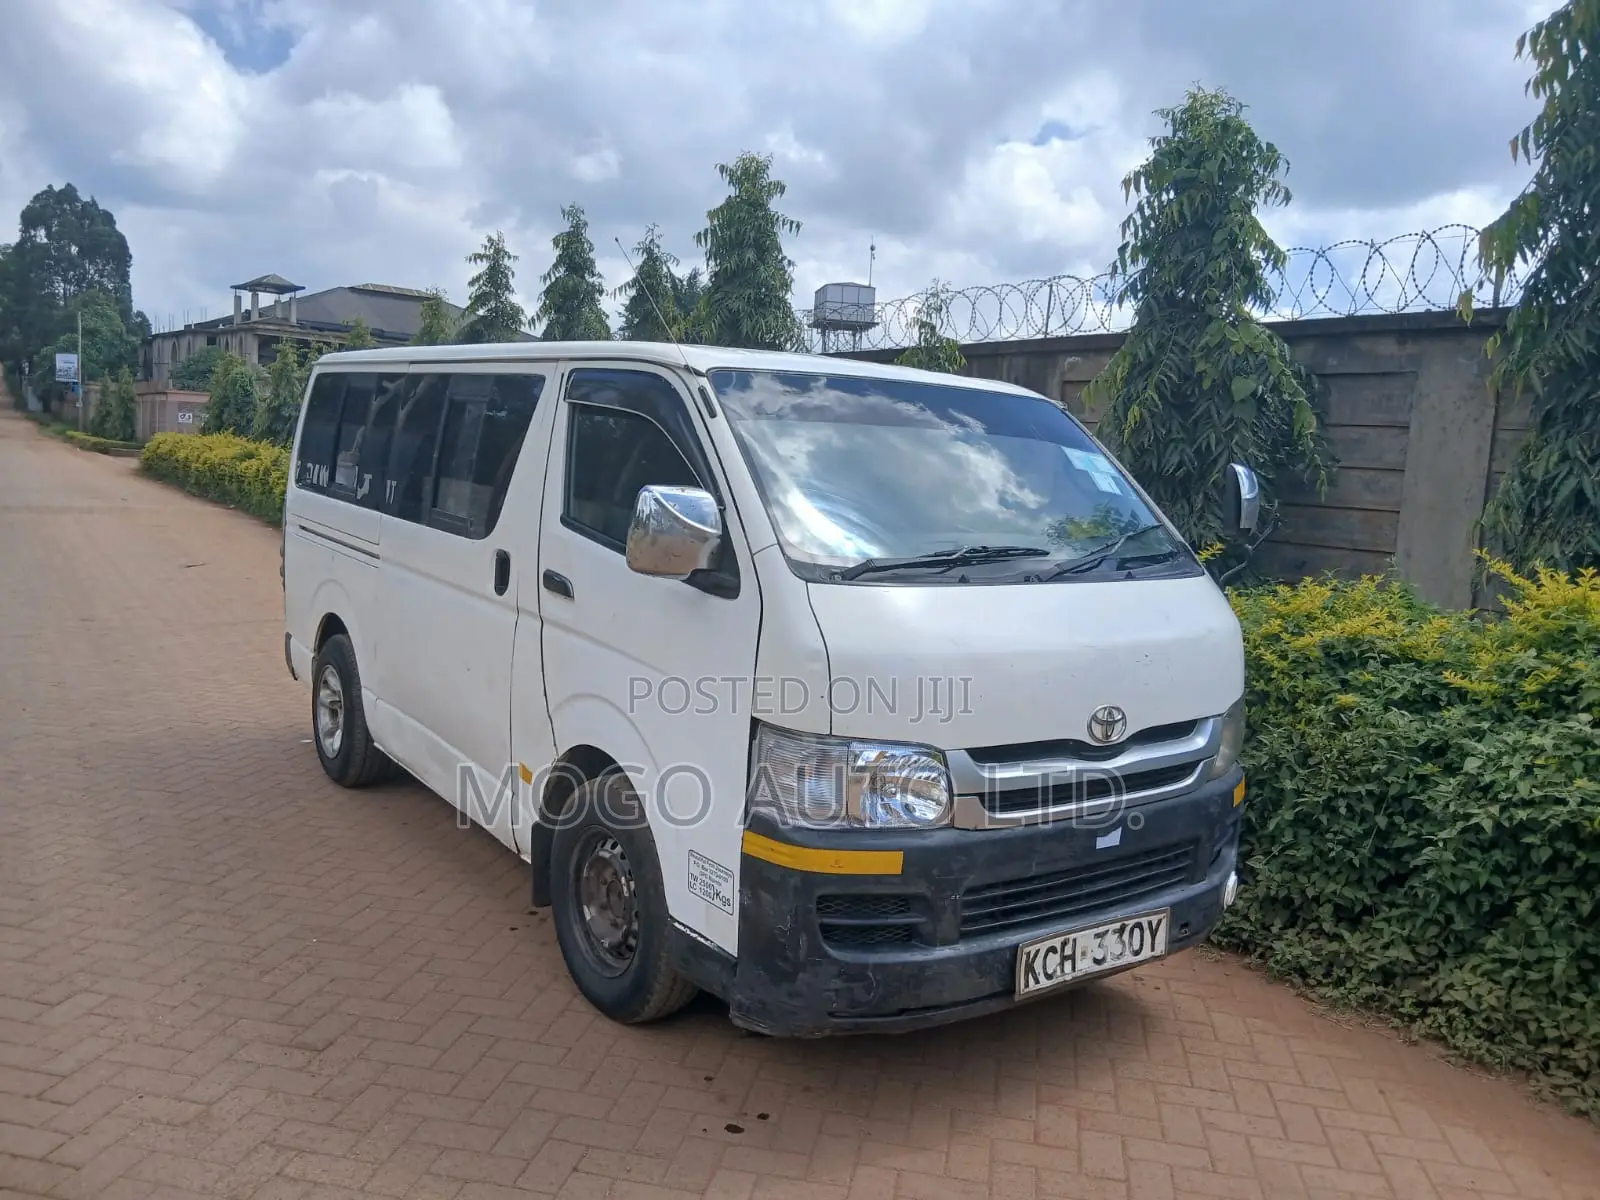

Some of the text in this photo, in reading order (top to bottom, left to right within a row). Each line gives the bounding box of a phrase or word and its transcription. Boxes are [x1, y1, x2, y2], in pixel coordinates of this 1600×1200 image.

[690, 872, 699, 882] TW
[689, 881, 698, 891] LC
[1023, 918, 1163, 989] KCH 330Y
